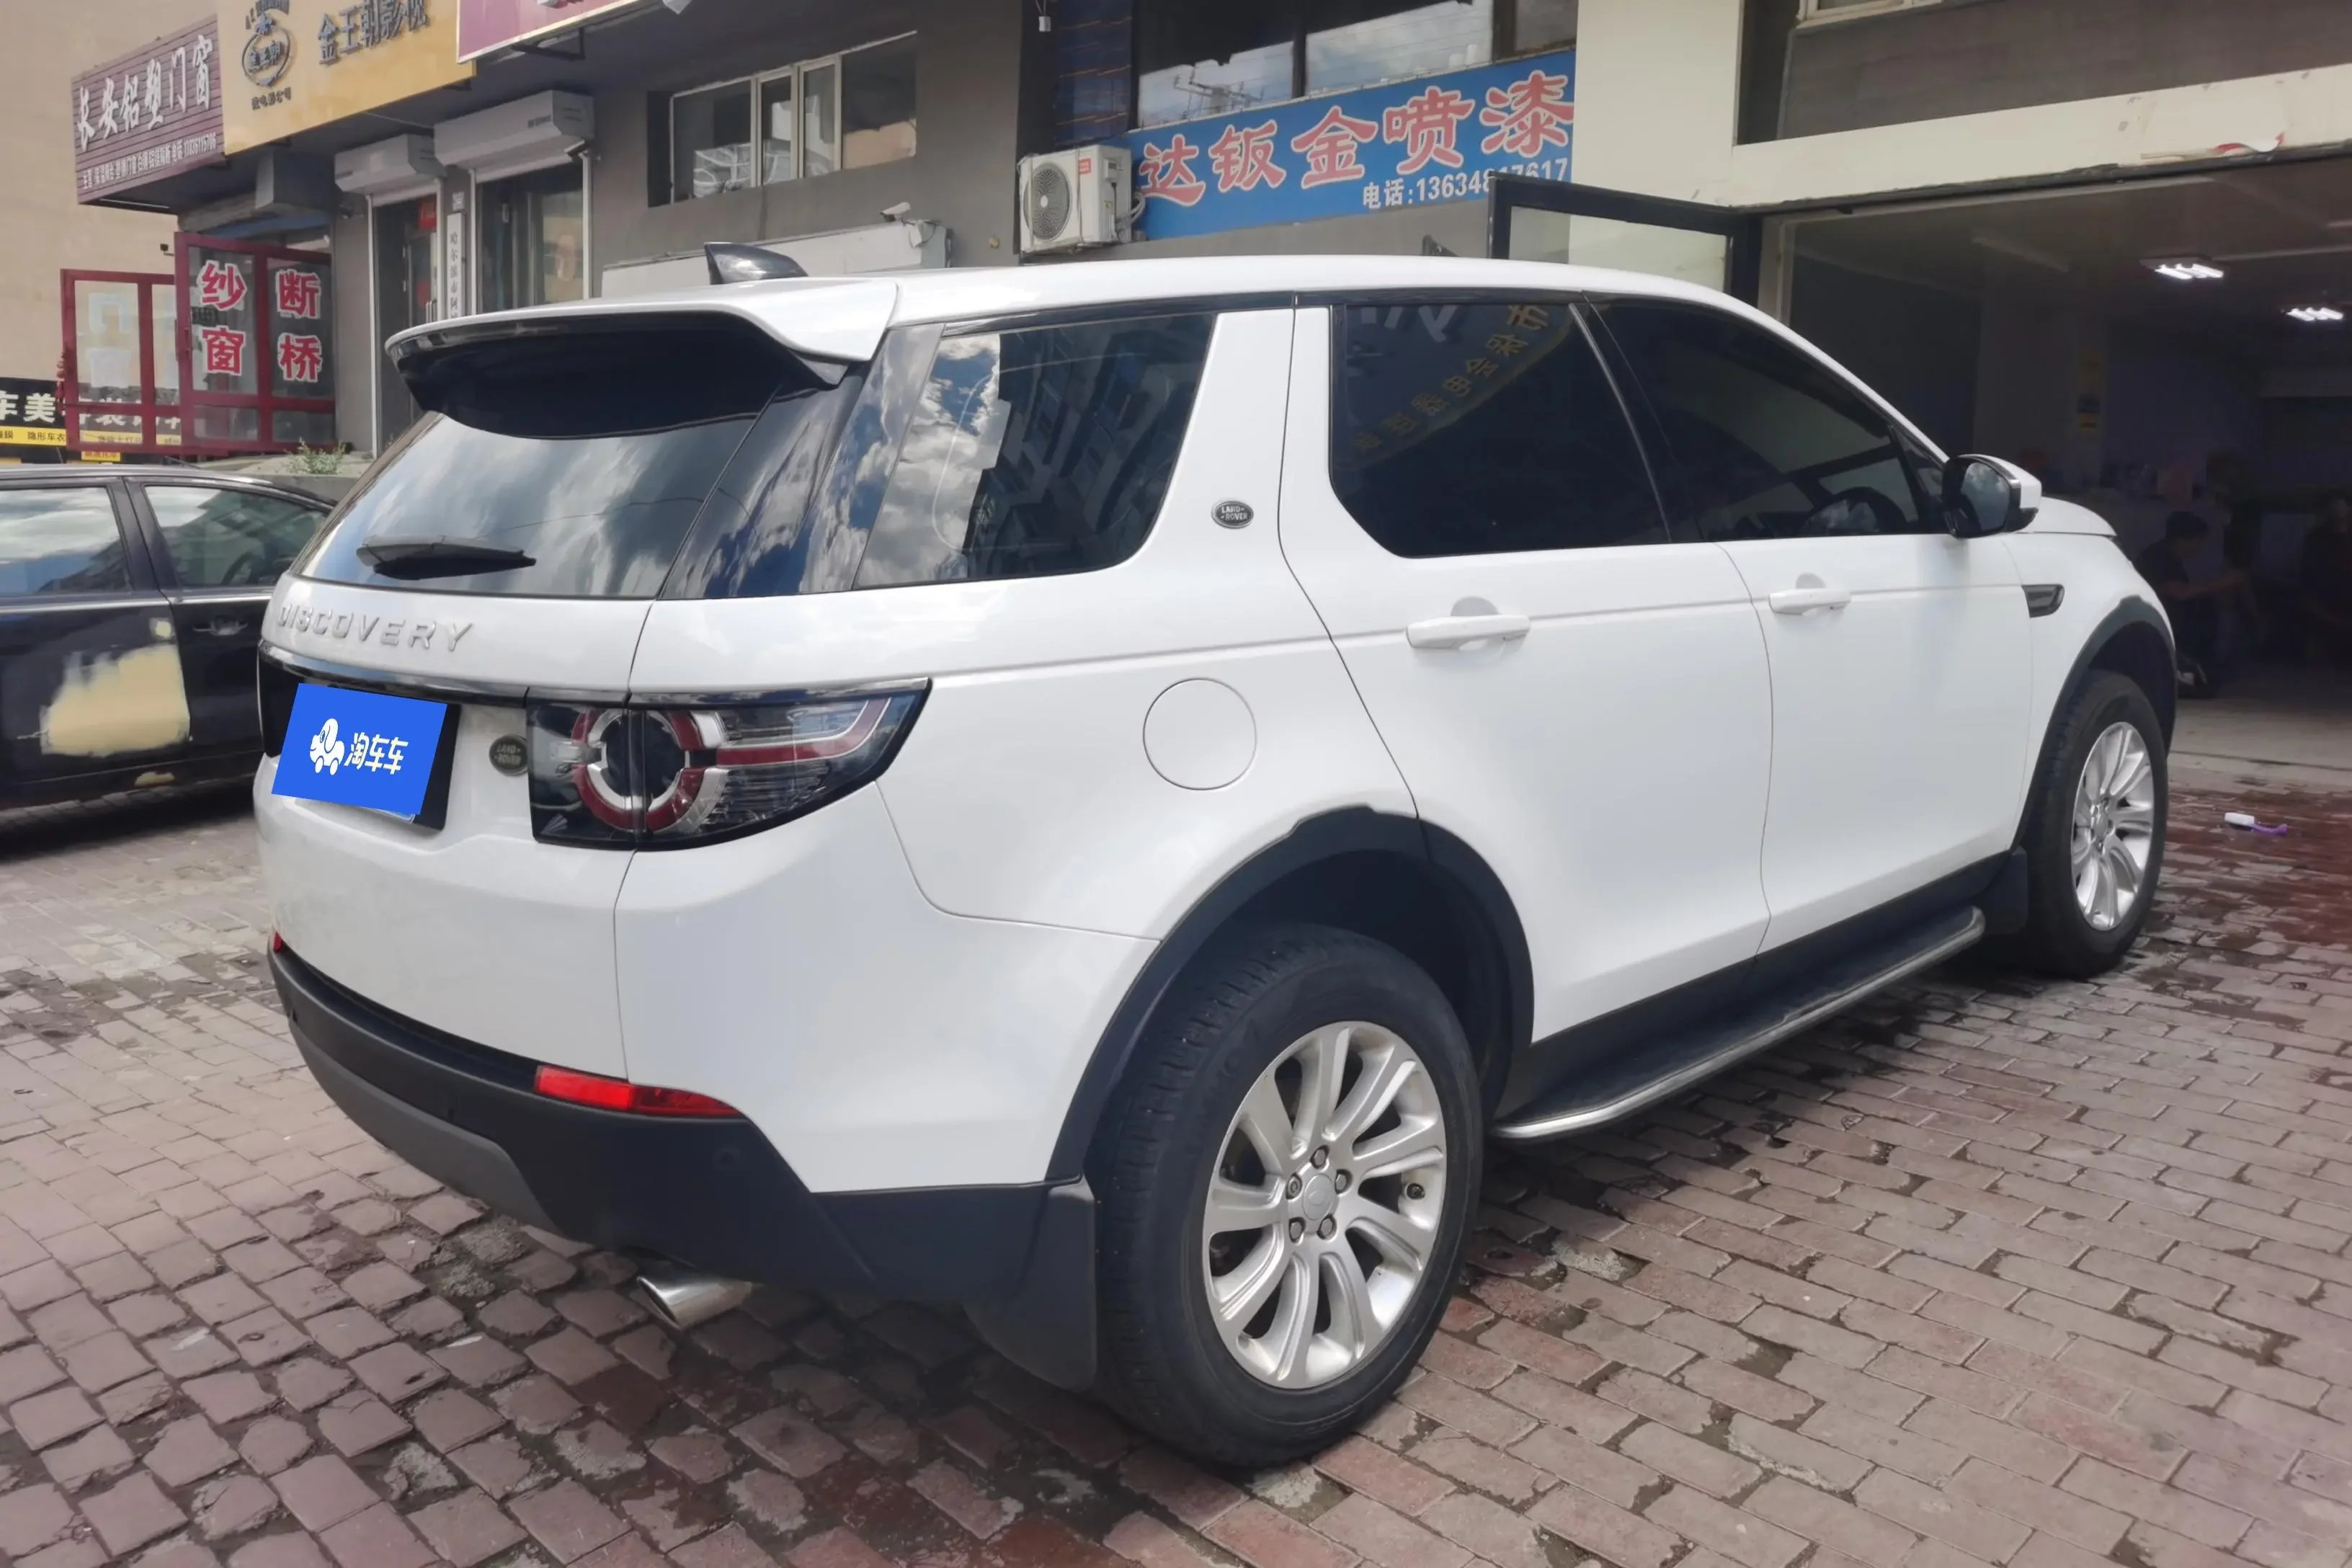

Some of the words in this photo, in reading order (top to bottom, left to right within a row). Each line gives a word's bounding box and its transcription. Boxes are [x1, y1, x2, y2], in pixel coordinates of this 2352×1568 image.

[1139, 69, 1576, 206] 达钣金喷漆
[1363, 158, 1568, 209] 电话:136348617
[199, 259, 247, 376] 纱窗
[276, 269, 321, 382] 断桥
[276, 603, 473, 652] DISCOVERY
